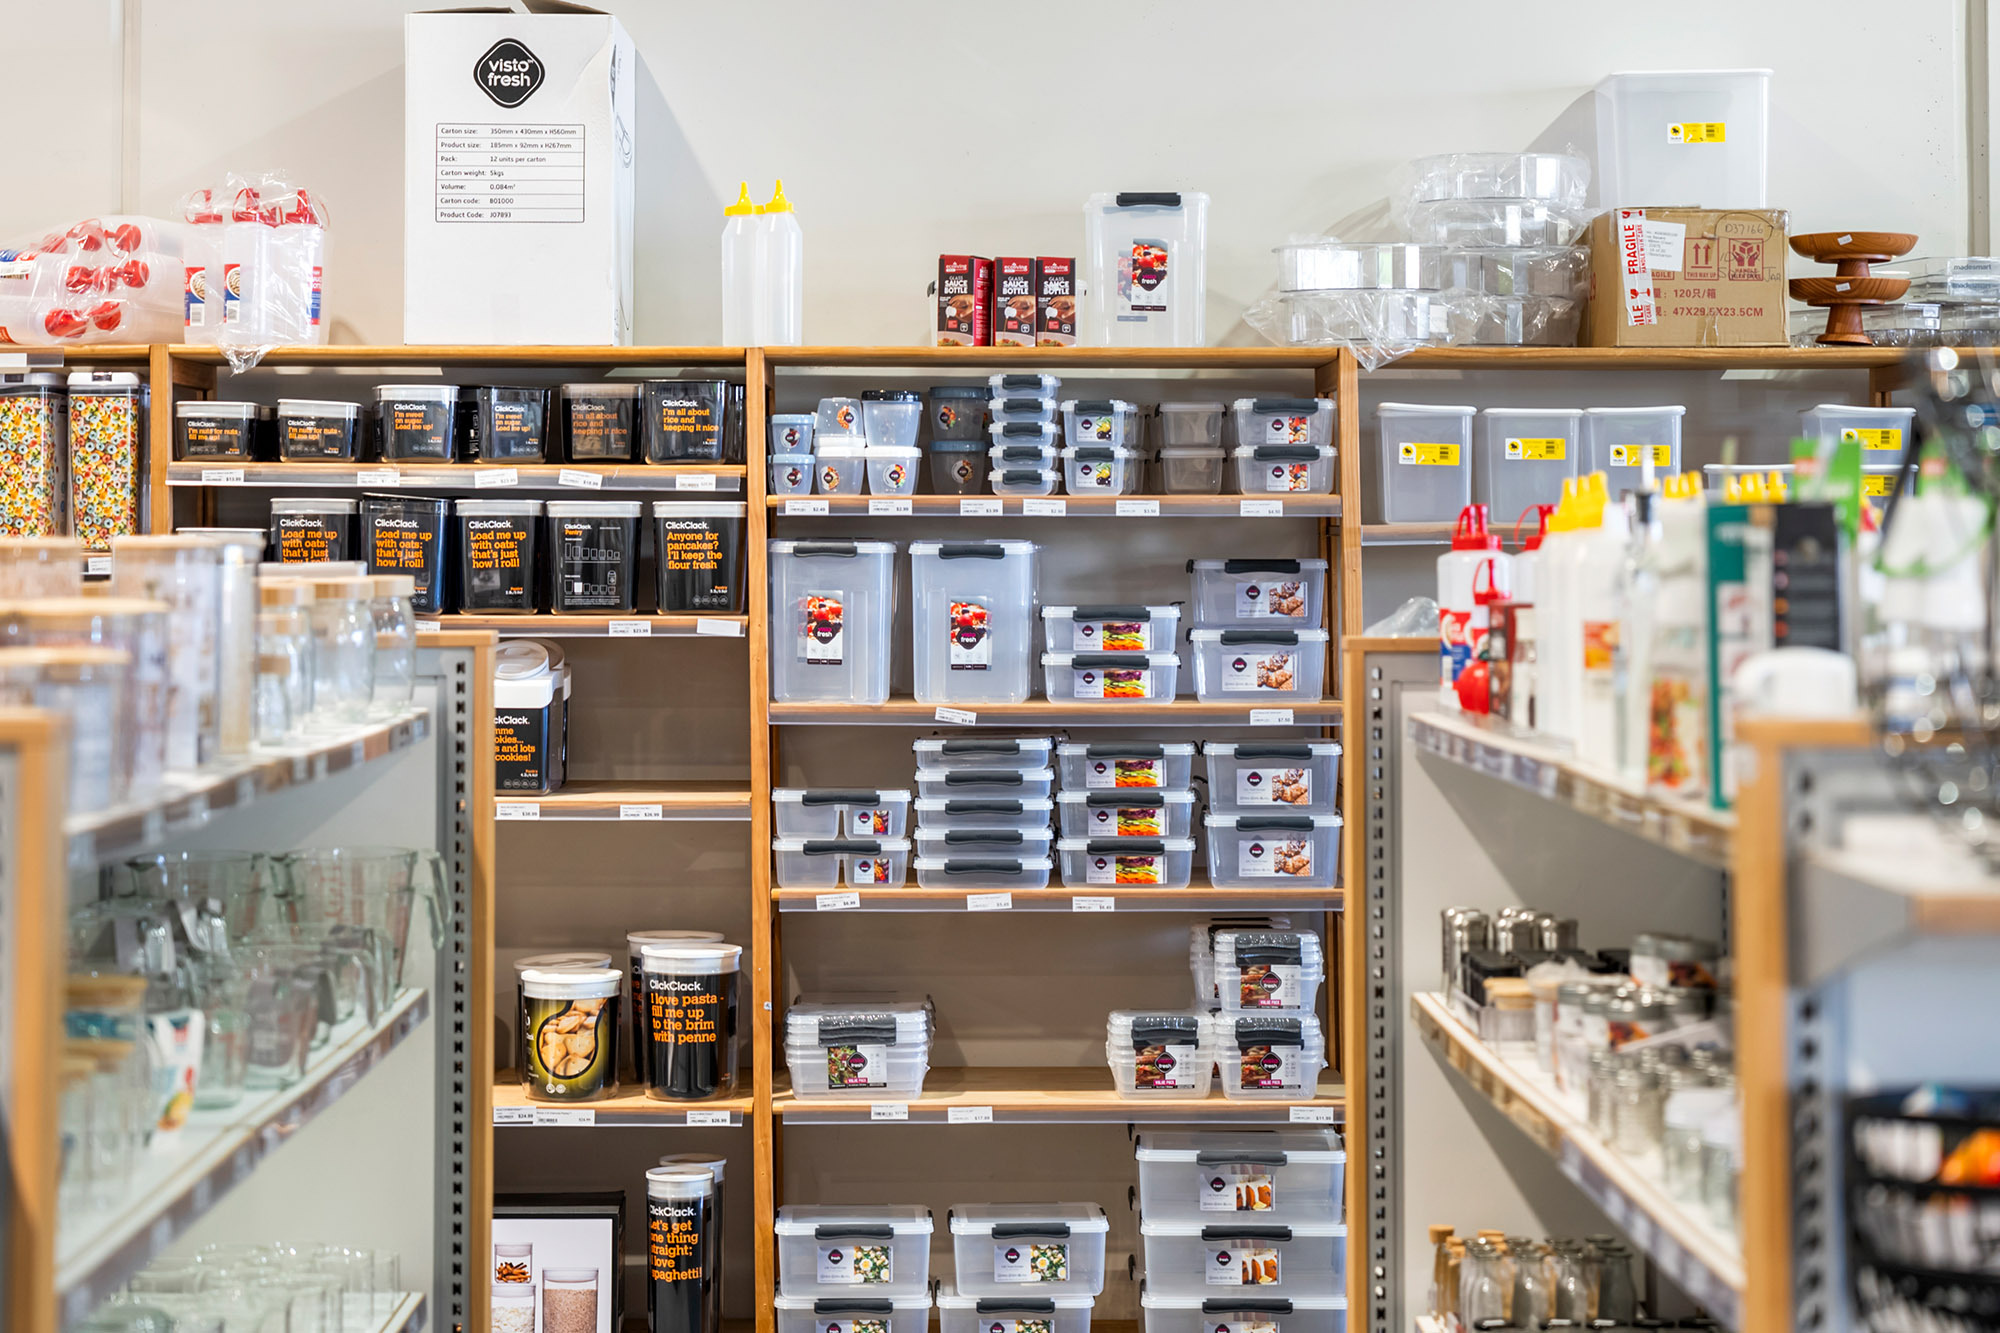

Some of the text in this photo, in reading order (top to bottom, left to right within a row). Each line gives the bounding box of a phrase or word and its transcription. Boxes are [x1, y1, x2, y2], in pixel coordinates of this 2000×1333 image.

[488, 72, 530, 87] fresh
[1725, 224, 1764, 235] D37166
[1624, 224, 1639, 274] FRAGILE
[663, 424, 694, 432] keeping
[281, 530, 305, 538] Load
[324, 531, 337, 540] up
[376, 529, 399, 538] Load
[419, 531, 432, 541] up
[470, 531, 494, 540] Load
[513, 531, 526, 541] up
[666, 531, 718, 542] Anyone for
[282, 539, 328, 548] with oats:
[376, 539, 423, 548] with oats:
[471, 541, 517, 549] with oats:
[668, 541, 718, 551] pancakes?
[282, 548, 329, 558] that's just
[376, 548, 423, 559] that's just
[472, 550, 518, 560] that's just
[668, 551, 722, 561] I'll keep the
[376, 558, 424, 567] how I roll!
[473, 559, 520, 568] how I roll!
[668, 560, 717, 569] flour fresh
[502, 744, 518, 752] and
[520, 744, 536, 752] lots
[495, 753, 531, 761] cookies!
[656, 993, 678, 1005] love
[682, 993, 717, 1007] pasta
[652, 1005, 704, 1020] fill me up
[652, 1018, 714, 1030] to the brim
[654, 1031, 717, 1045] with penne
[672, 1220, 692, 1234] get
[667, 1232, 698, 1245] thing
[654, 1255, 675, 1269] love
